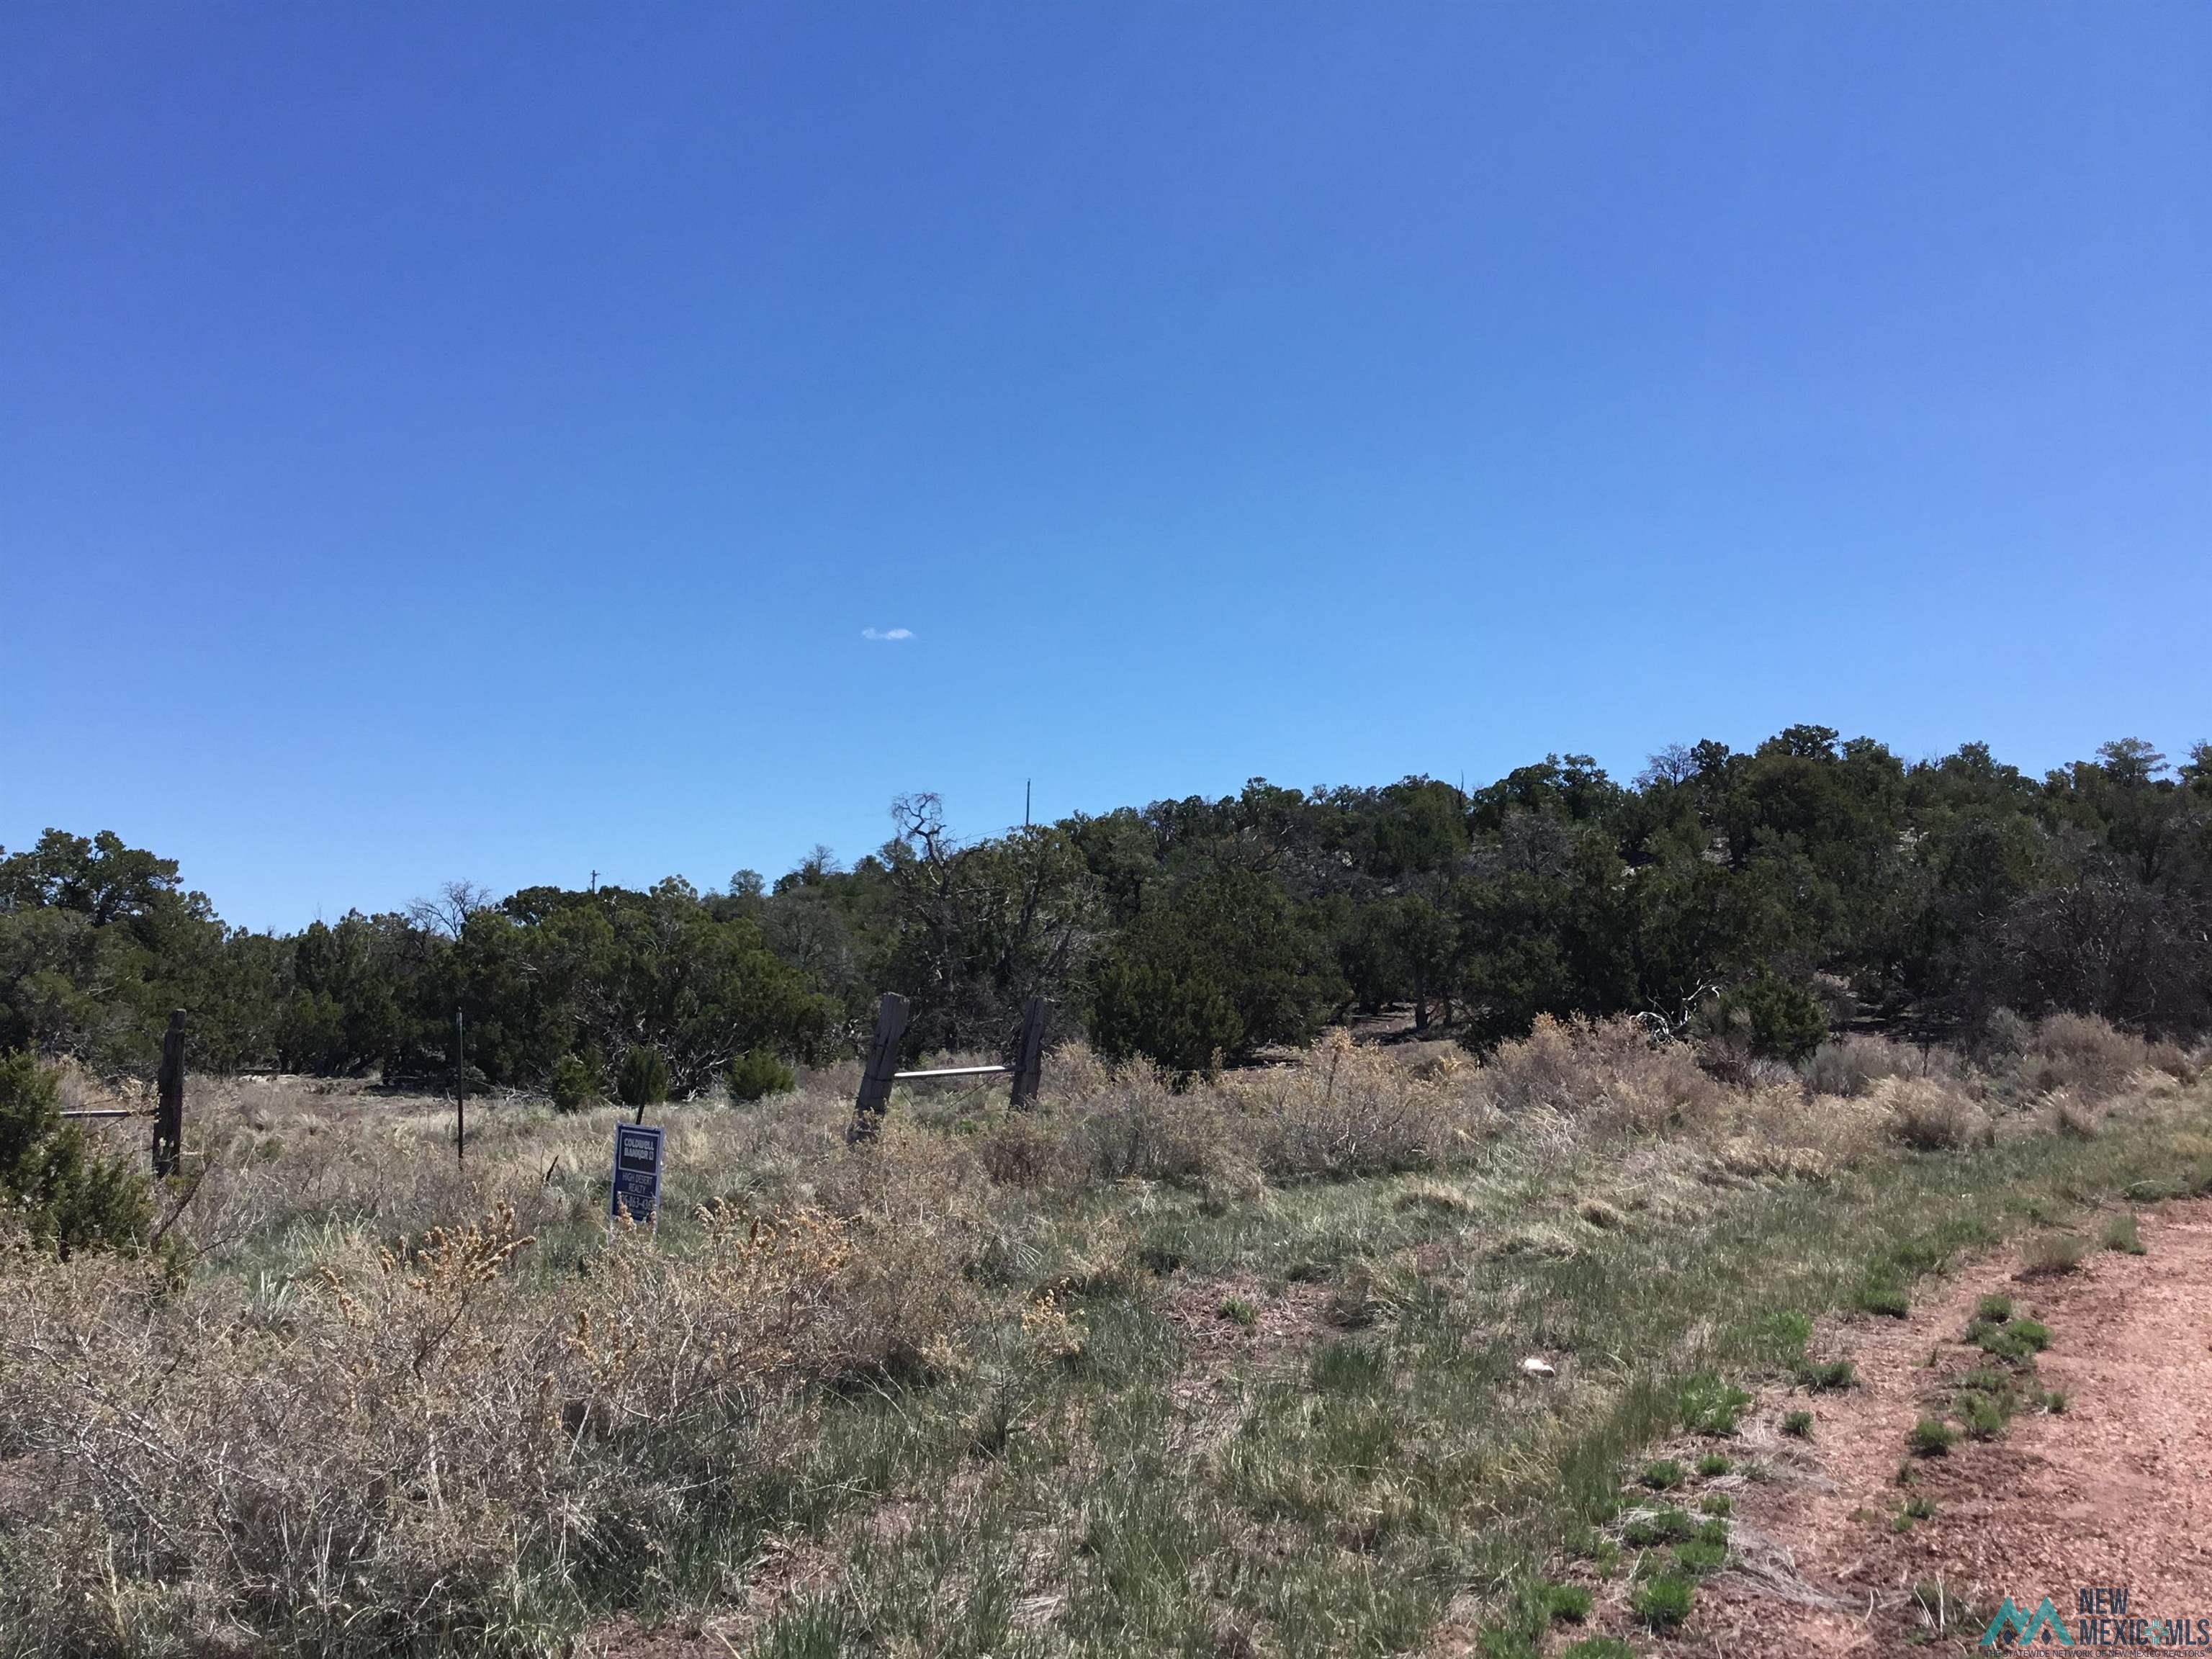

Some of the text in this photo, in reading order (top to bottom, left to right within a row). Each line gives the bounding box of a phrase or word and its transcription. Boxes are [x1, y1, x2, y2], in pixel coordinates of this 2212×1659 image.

[624, 1138, 654, 1151] COLDWELL
[624, 1147, 649, 1160] BANKER
[622, 1172, 652, 1186] HIGH DESERT
[629, 1183, 646, 1195] REALTY
